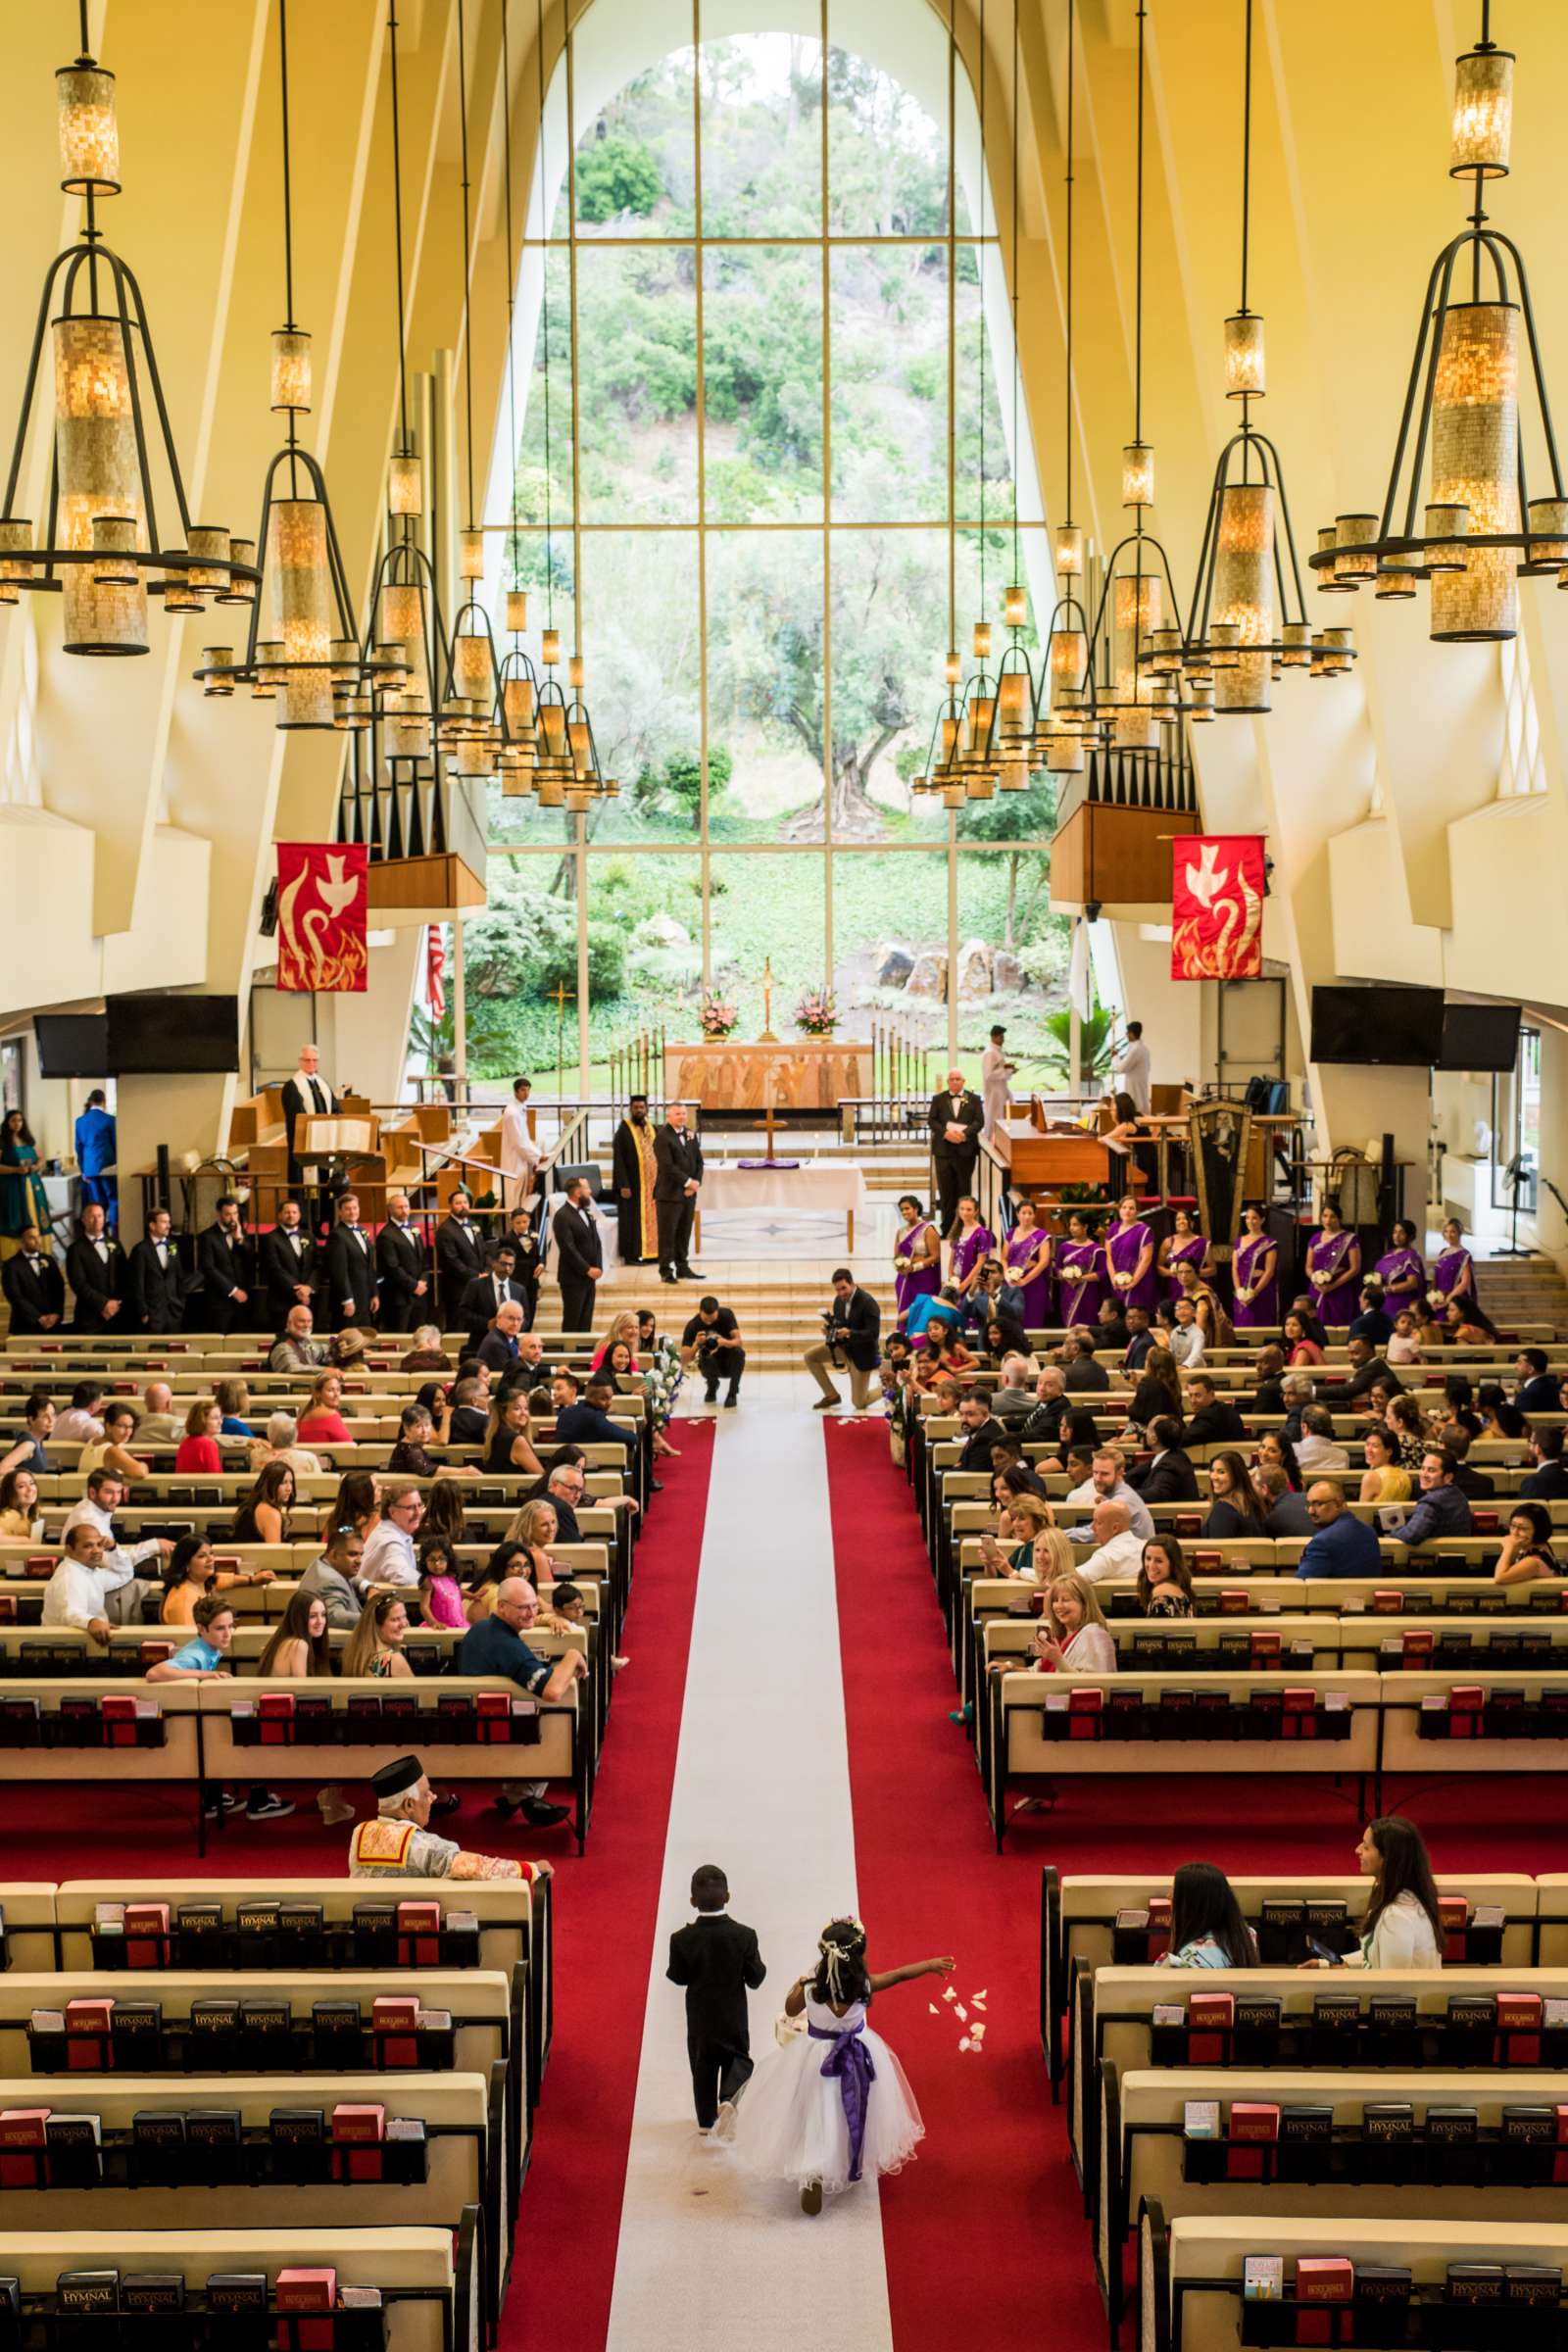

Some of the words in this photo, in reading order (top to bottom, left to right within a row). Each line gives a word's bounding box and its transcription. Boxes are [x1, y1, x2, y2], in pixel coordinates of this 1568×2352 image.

[181, 1917, 218, 1927] HYMNAL
[240, 1917, 276, 1926] HYMNAL
[1239, 2010, 1277, 2019] HYMNAL
[1318, 2010, 1356, 2019] HYMNAL
[1375, 2011, 1411, 2020] HYMNAL
[1452, 2011, 1490, 2020] HYMNAL
[115, 2016, 154, 2026] HYMNAL
[1287, 2123, 1328, 2132] HYMNAL
[1369, 2122, 1411, 2132] HYMNAL
[1431, 2124, 1472, 2132] HYMNAL
[1508, 2124, 1550, 2133] HYMNAL
[1452, 2284, 1500, 2296] HYMNAL
[1510, 2285, 1557, 2297] HYMNAL
[64, 2291, 111, 2302] HYMNAL
[127, 2292, 173, 2304] HYMNAL
